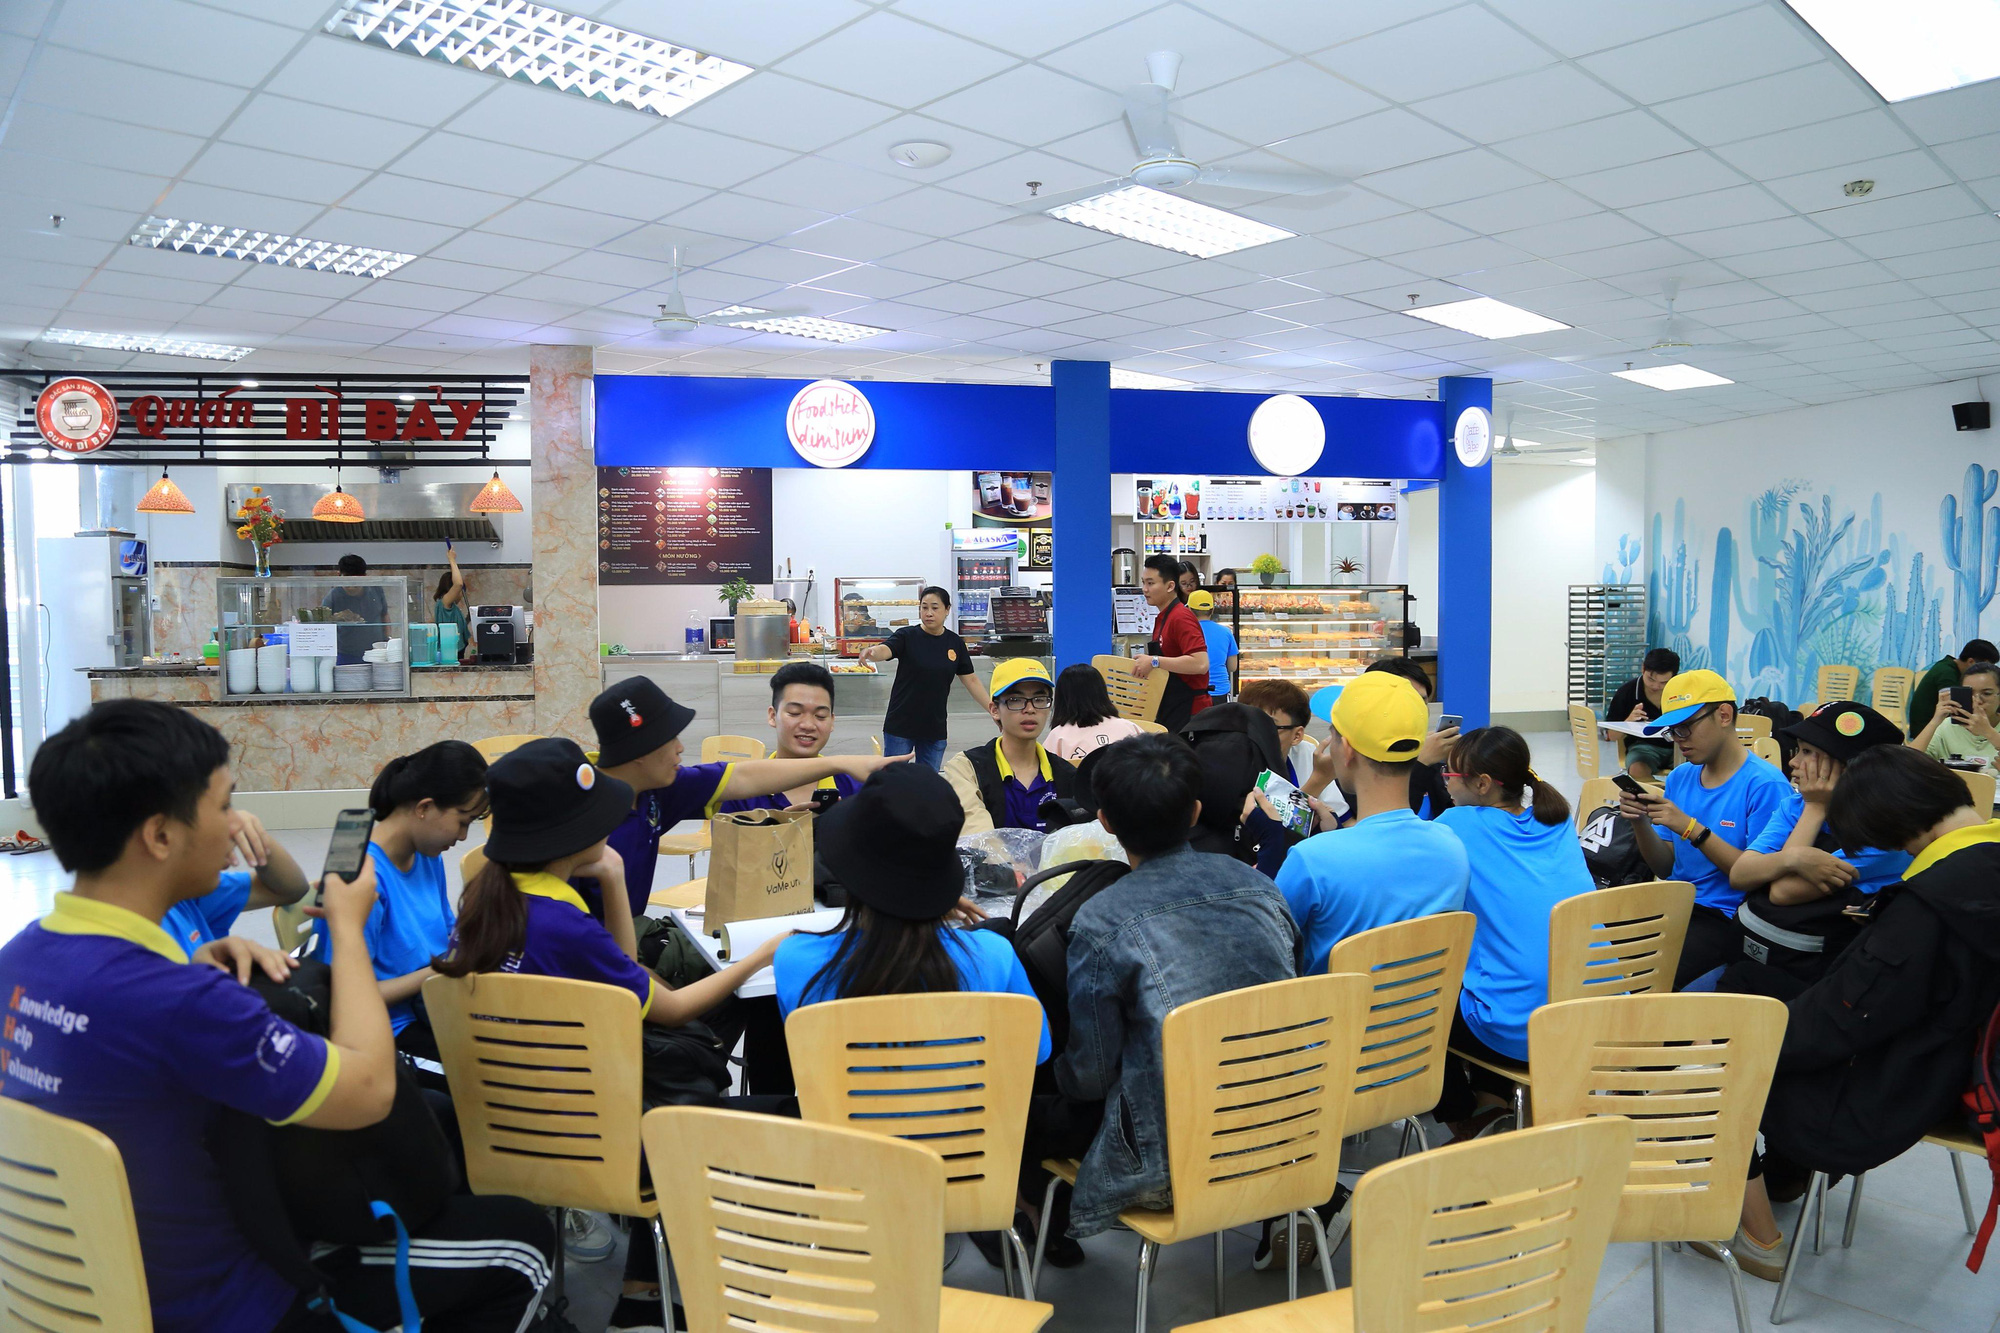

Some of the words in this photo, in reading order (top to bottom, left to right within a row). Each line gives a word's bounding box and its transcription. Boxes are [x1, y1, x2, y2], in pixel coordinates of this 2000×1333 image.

[129, 385, 255, 441] Quán
[3, 1014, 33, 1051] Help
[9, 985, 89, 1034] Knowledge
[1, 1048, 62, 1094] Volunteer
